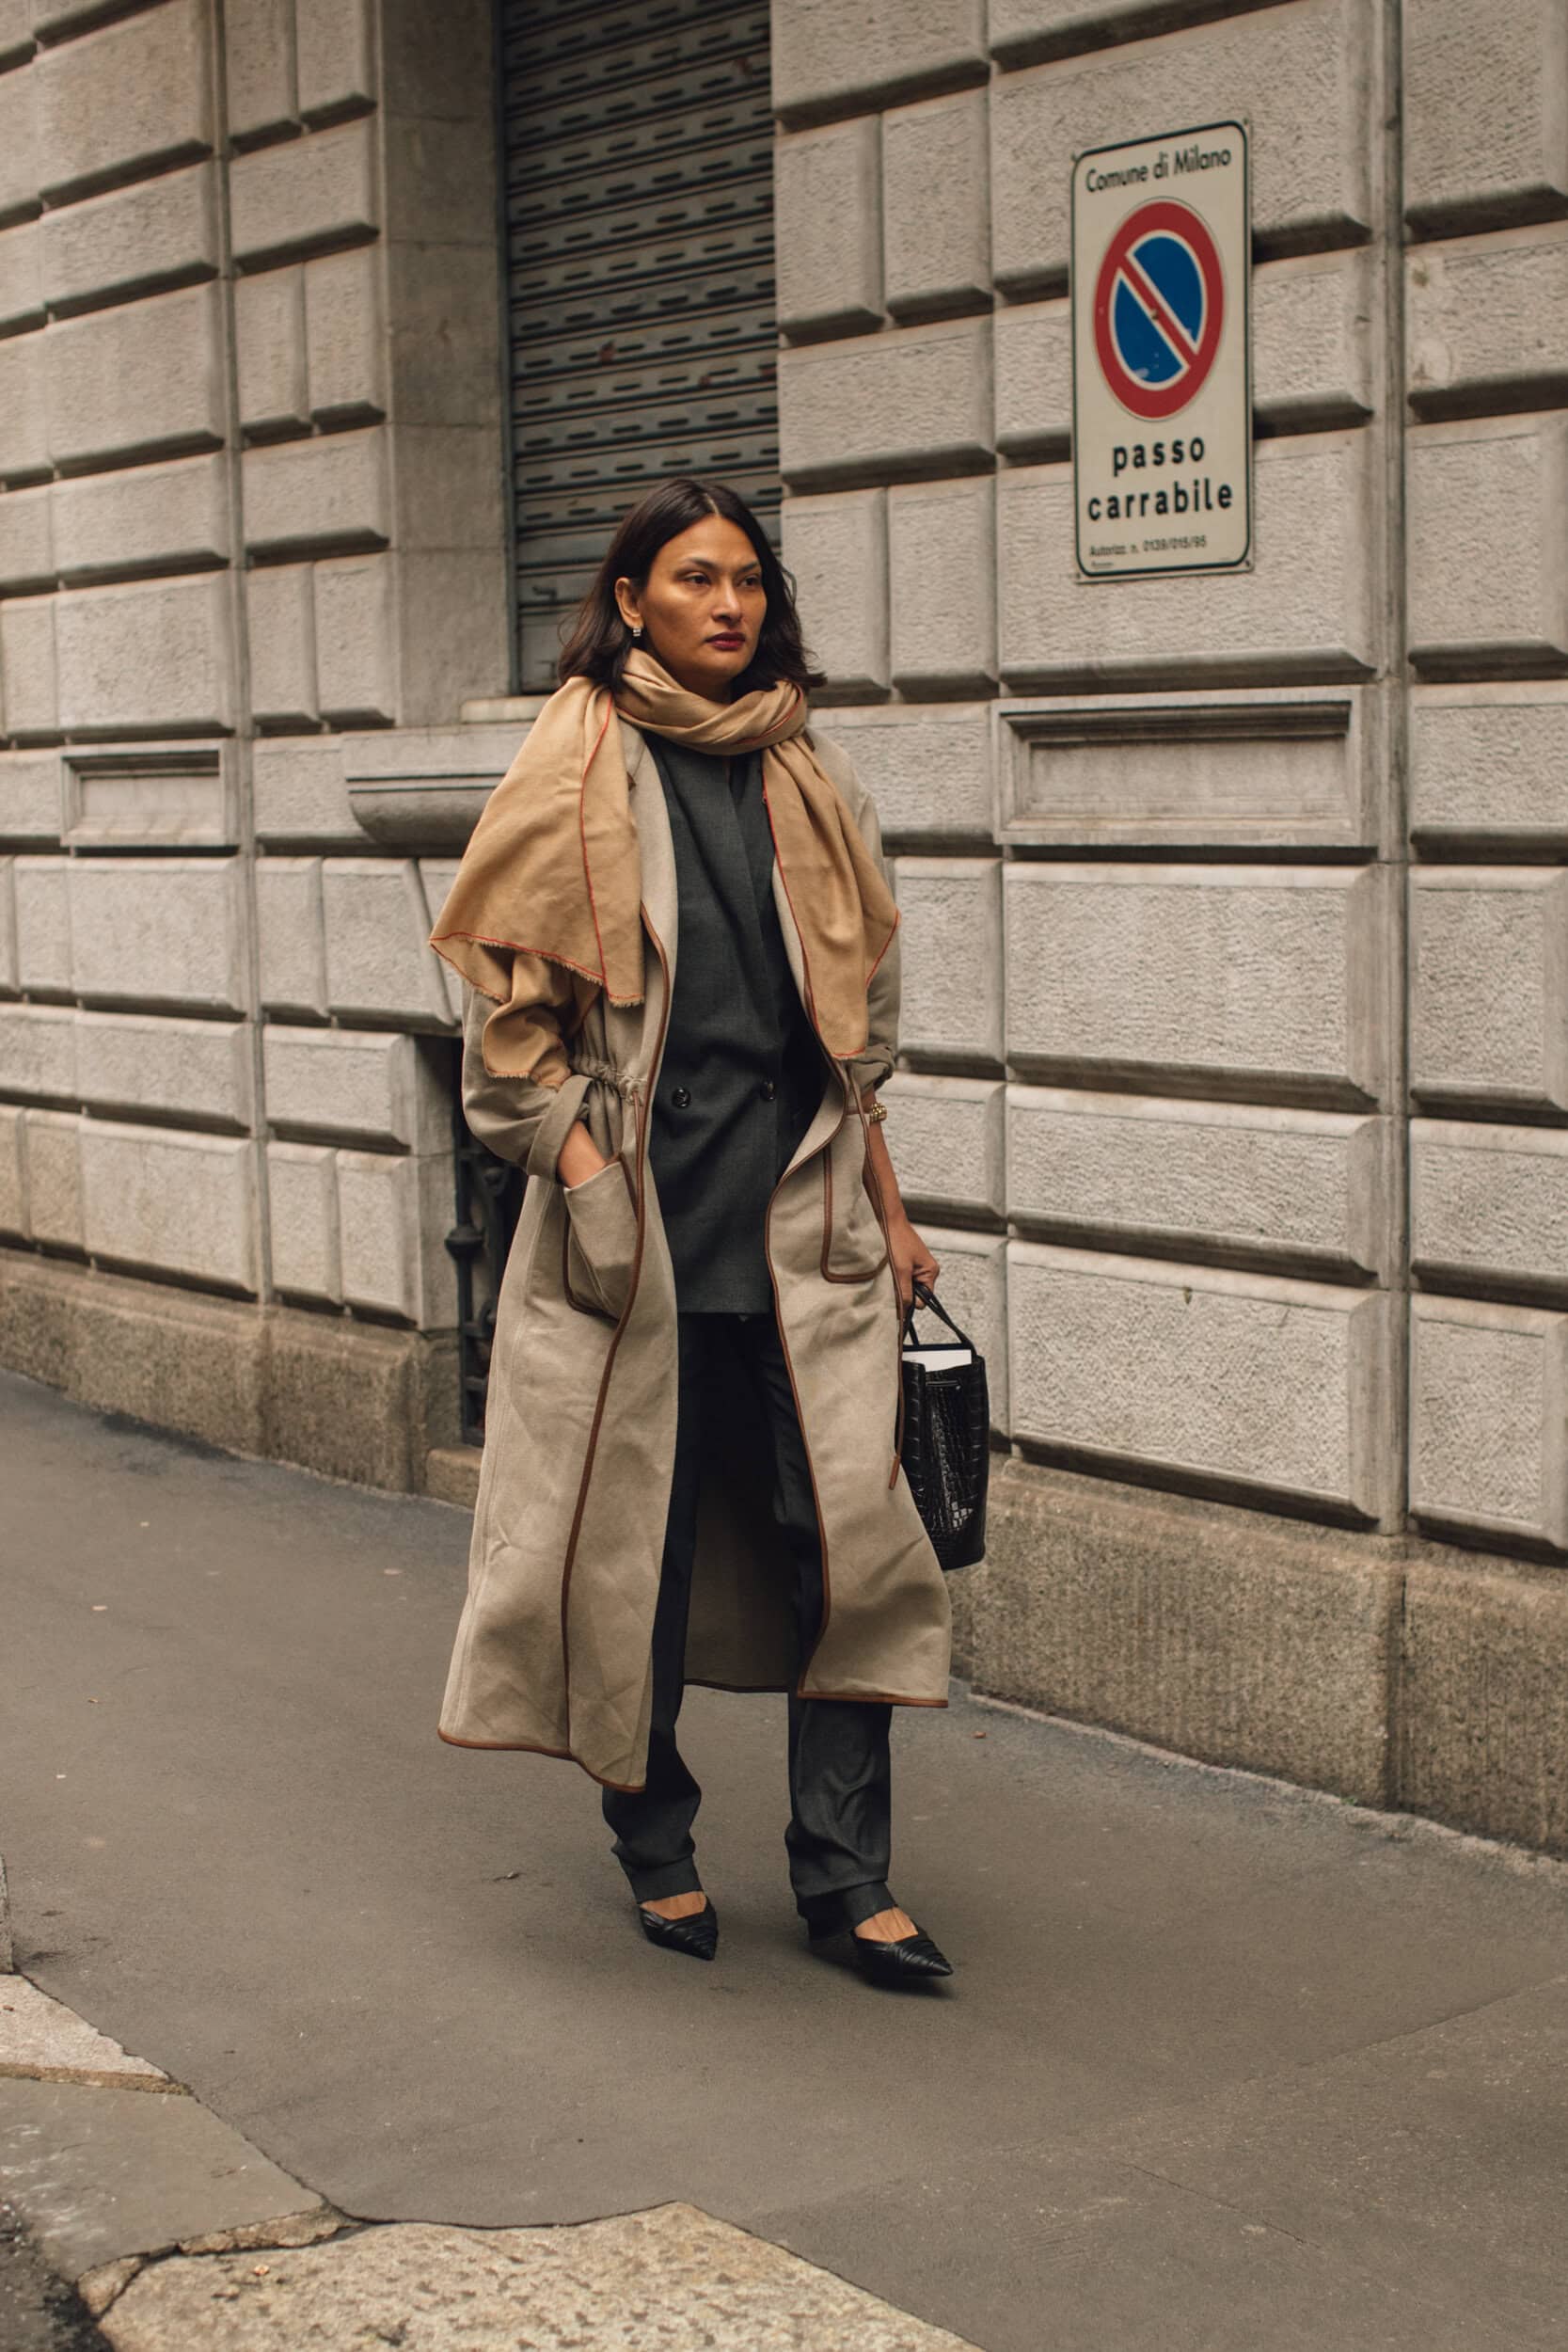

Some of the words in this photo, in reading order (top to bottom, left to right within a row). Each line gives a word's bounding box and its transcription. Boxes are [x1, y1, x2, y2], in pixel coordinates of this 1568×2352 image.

[1086, 165, 1148, 193] Comune
[1153, 151, 1169, 179] di
[1174, 144, 1231, 175] Milano
[1113, 437, 1205, 477] passo
[1088, 477, 1232, 521] carrabile
